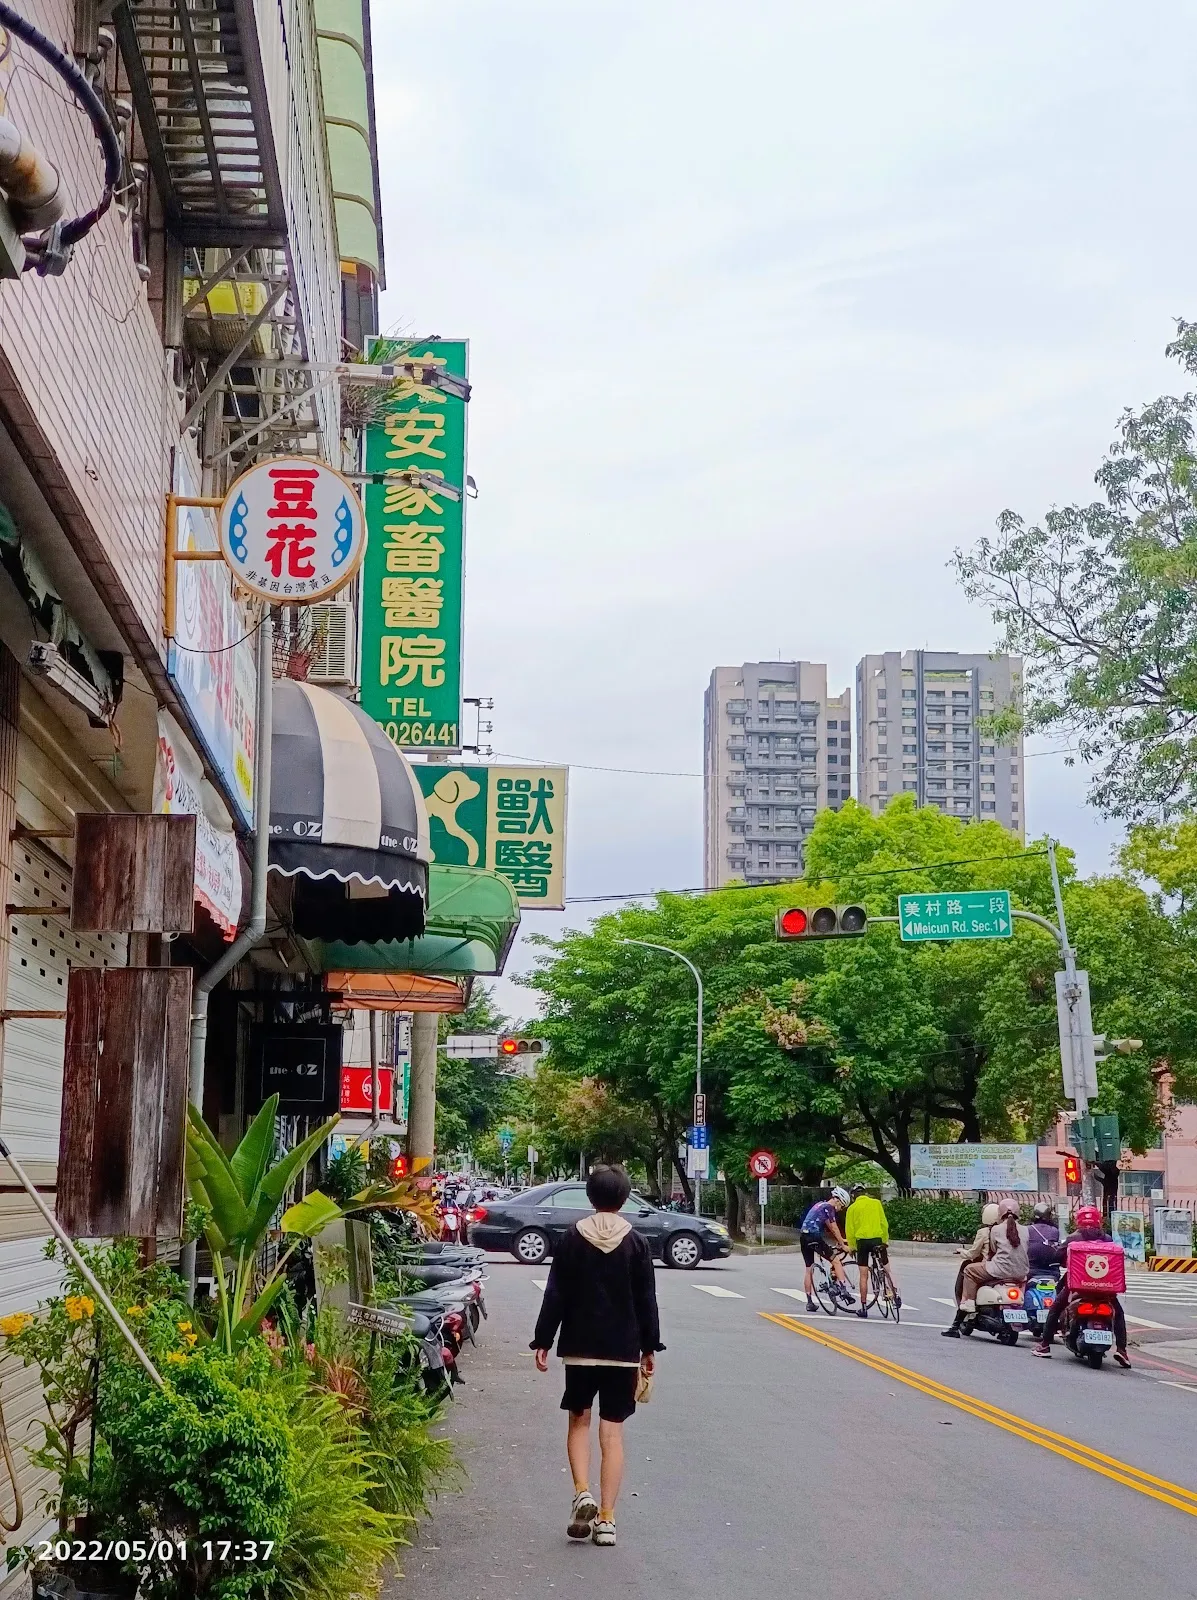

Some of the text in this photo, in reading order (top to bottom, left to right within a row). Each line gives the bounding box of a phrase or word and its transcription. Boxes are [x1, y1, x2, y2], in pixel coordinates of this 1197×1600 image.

[265, 469, 320, 578] 豆花
[386, 697, 432, 717] TEL
[292, 820, 322, 837] OZ
[494, 777, 554, 898] 獸醫
[380, 834, 418, 853] the OZ
[904, 897, 1006, 918] 美村路一段
[913, 922, 950, 935] Meicun
[952, 920, 969, 933] Rd.
[269, 1063, 318, 1076] the OZ
[1080, 1279, 1114, 1288] foodpanda
[346, 1315, 358, 1324] NO
